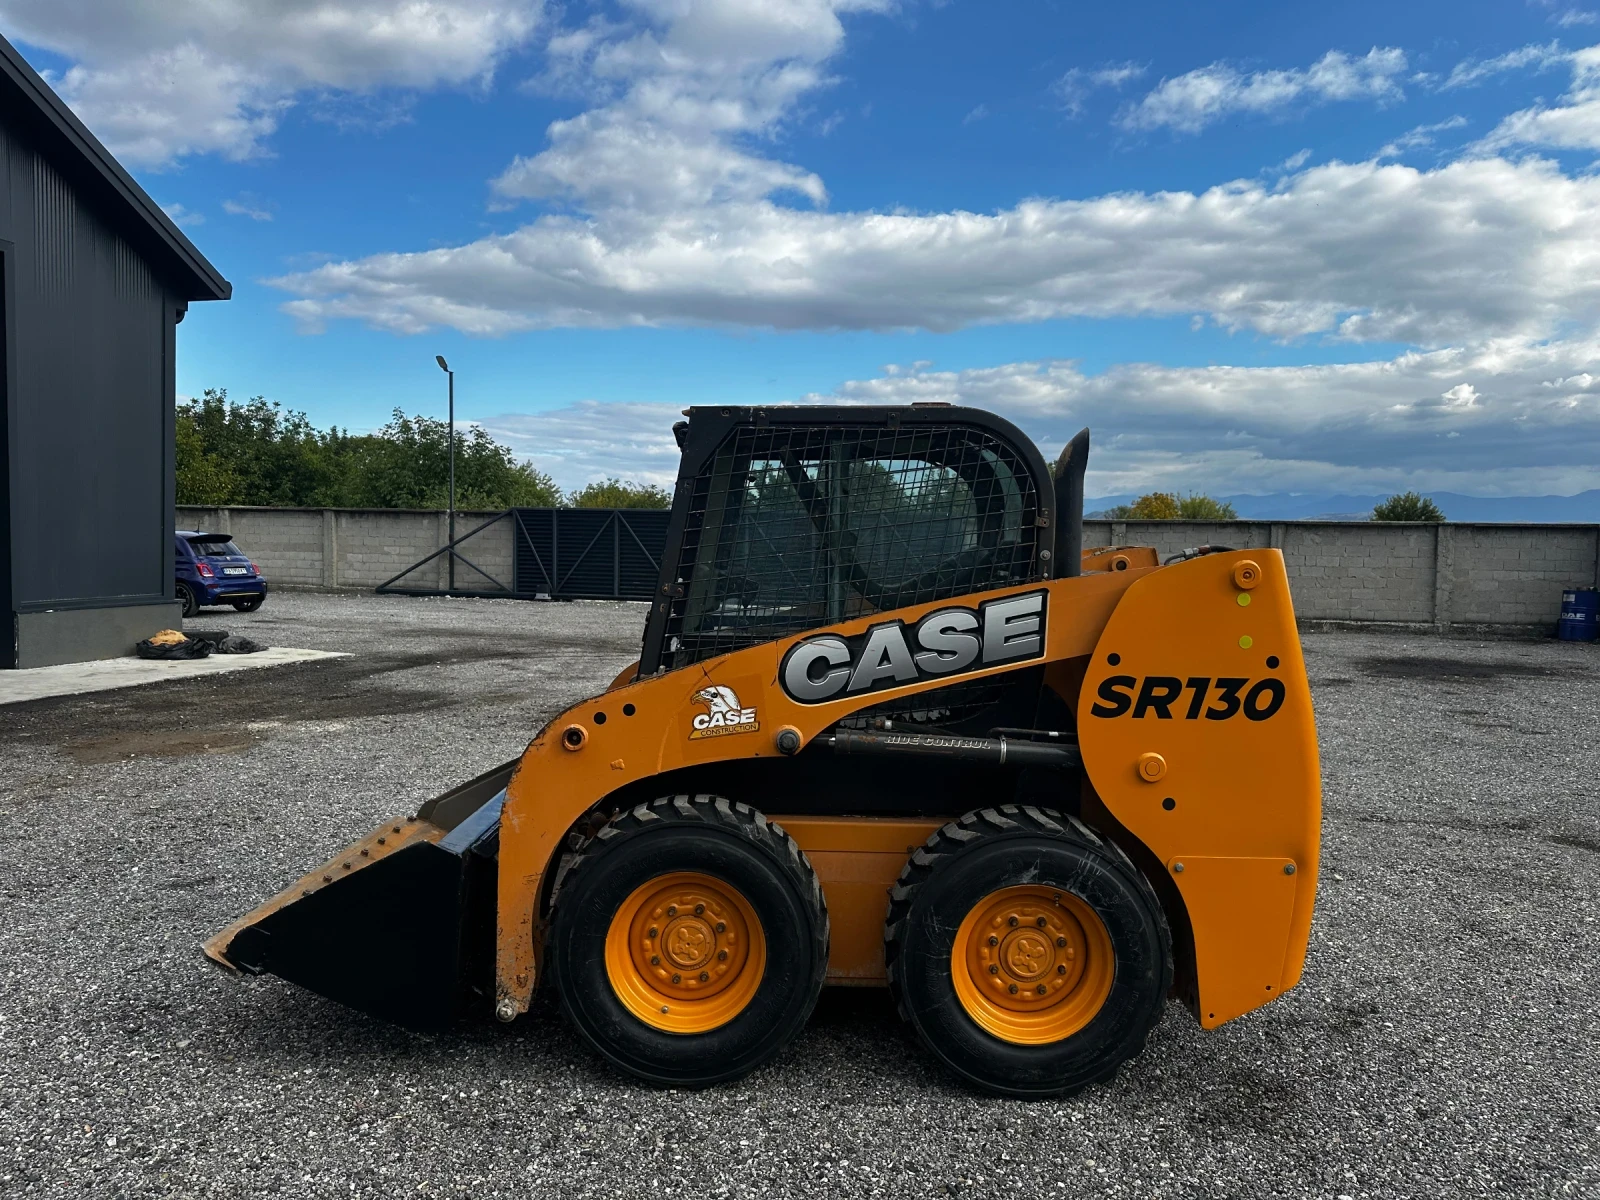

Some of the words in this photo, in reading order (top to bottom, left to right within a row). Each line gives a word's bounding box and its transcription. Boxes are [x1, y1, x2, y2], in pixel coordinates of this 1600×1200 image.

[784, 594, 1044, 701] CASE
[1090, 674, 1286, 722] SR130
[693, 708, 756, 730] CASE
[700, 723, 757, 737] CONSTRUCTION
[884, 735, 920, 745] RIDE
[922, 738, 991, 750] CONTROL
